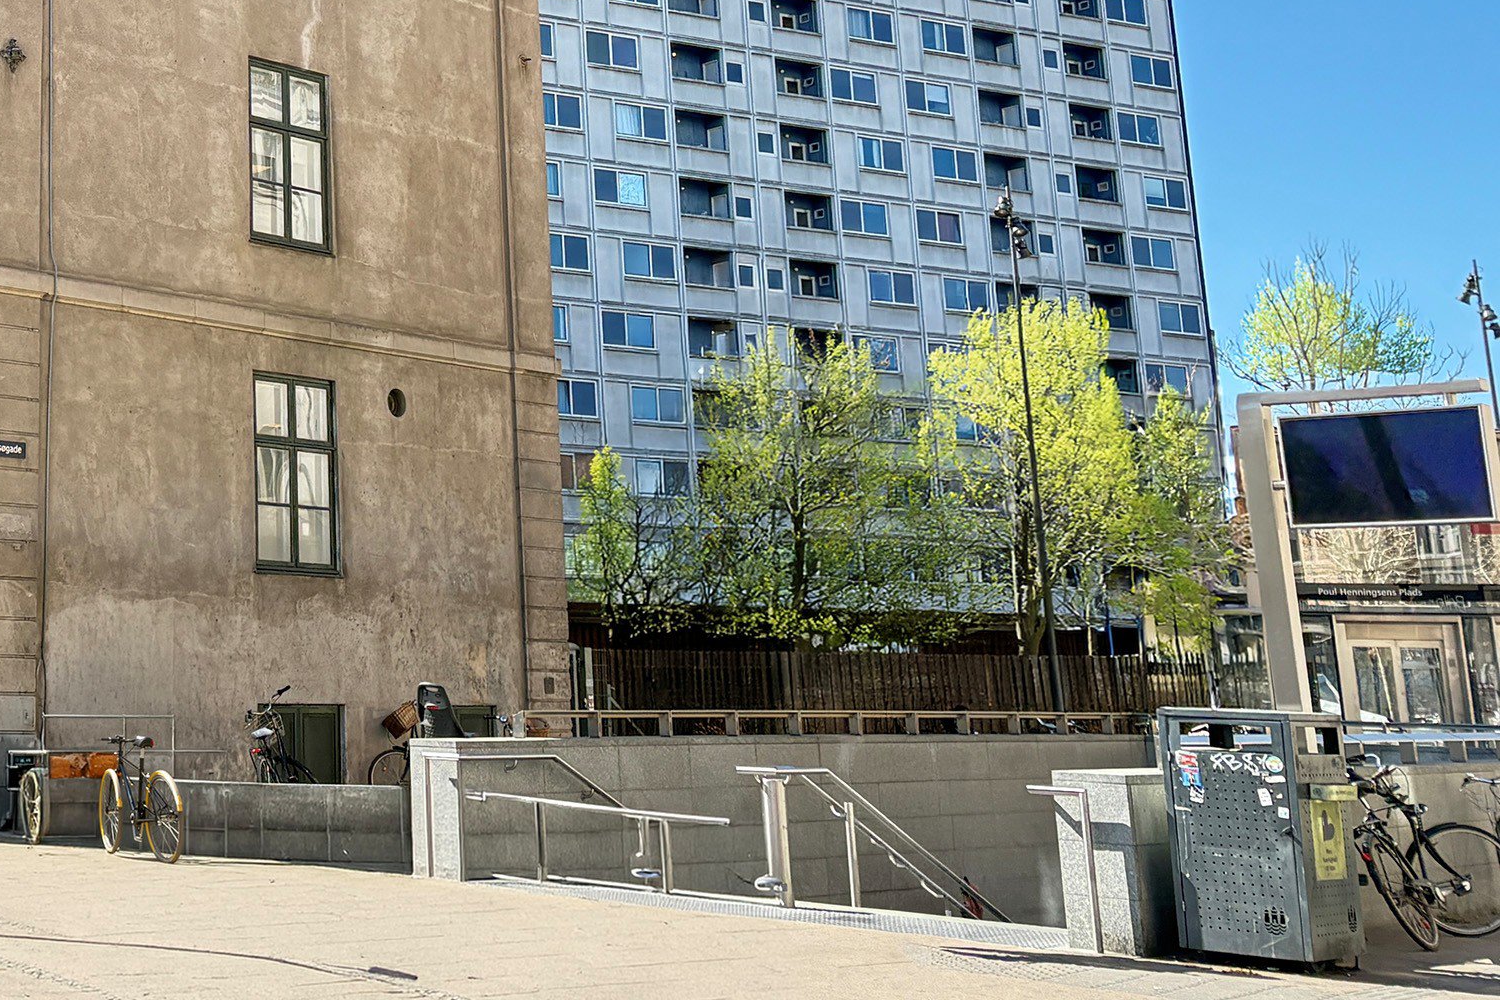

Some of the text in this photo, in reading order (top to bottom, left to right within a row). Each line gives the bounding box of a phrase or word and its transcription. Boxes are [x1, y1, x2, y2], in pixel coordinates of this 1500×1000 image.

[1318, 587, 1423, 598] Poul Henningsens Plads
